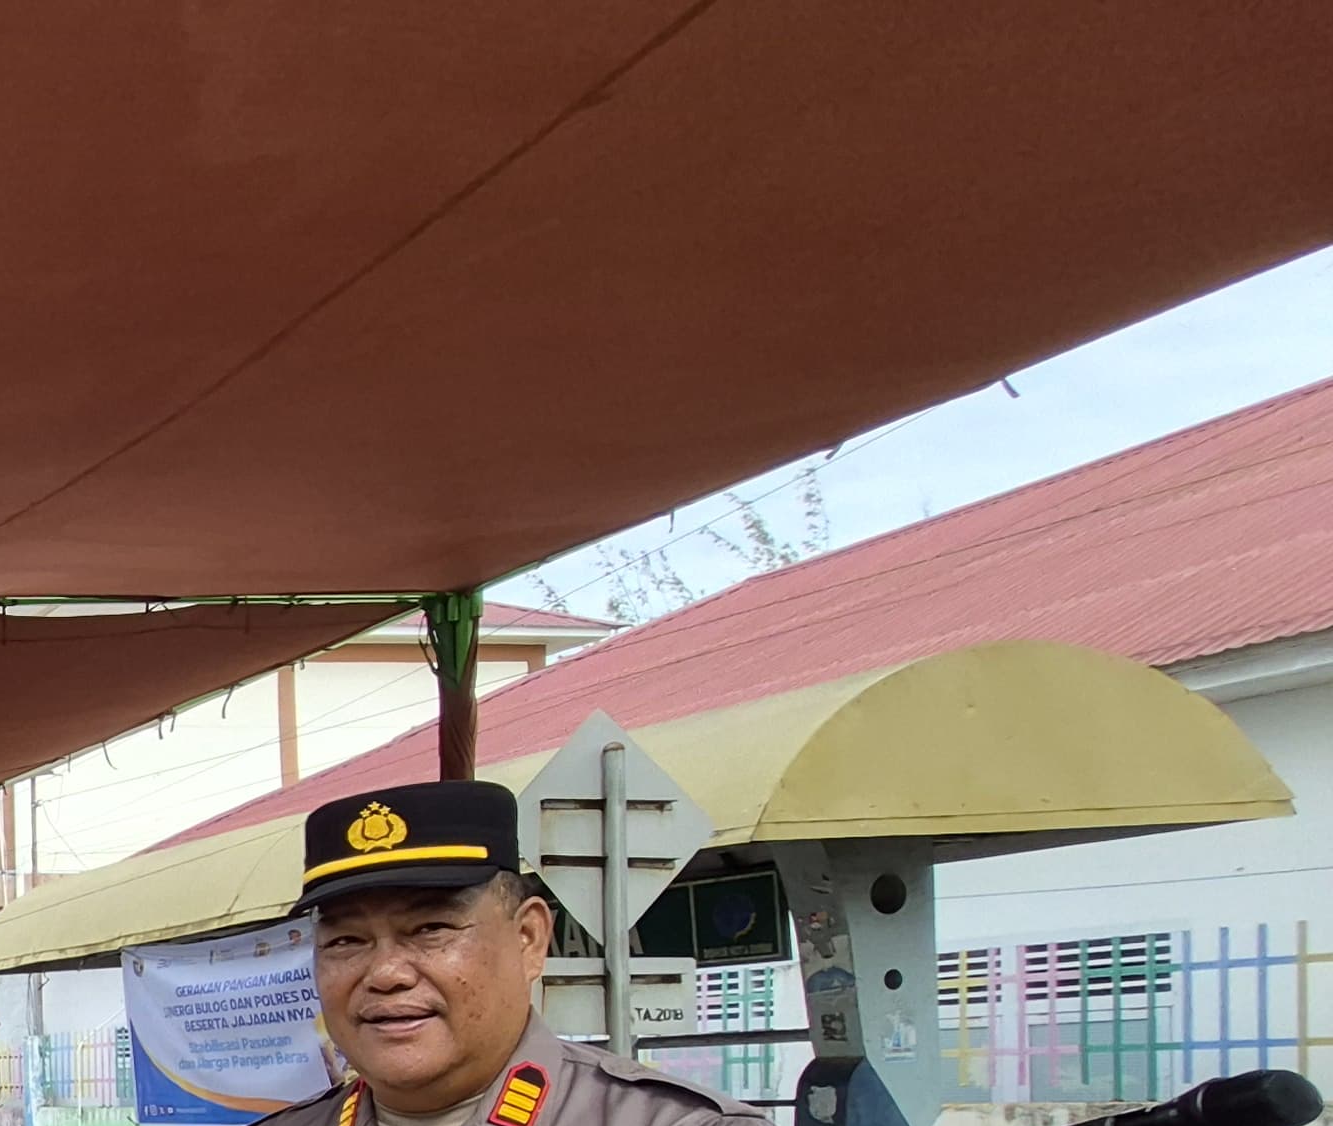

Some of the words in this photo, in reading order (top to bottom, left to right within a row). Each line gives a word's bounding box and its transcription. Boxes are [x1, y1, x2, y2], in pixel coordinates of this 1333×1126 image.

[175, 981, 221, 998] GERAKAN
[222, 975, 268, 992] PANGAN
[268, 968, 312, 985] MURAH
[196, 999, 228, 1014] BULOG
[231, 996, 253, 1011] DAN
[255, 990, 299, 1007] POLRES
[185, 1017, 229, 1032] BESERTA
[231, 1011, 285, 1028] JAJARAN
[288, 1007, 316, 1022] NYA
[242, 1035, 292, 1049] Pasokan
[232, 1053, 274, 1070] Pangan
[276, 1051, 310, 1065] Beras
